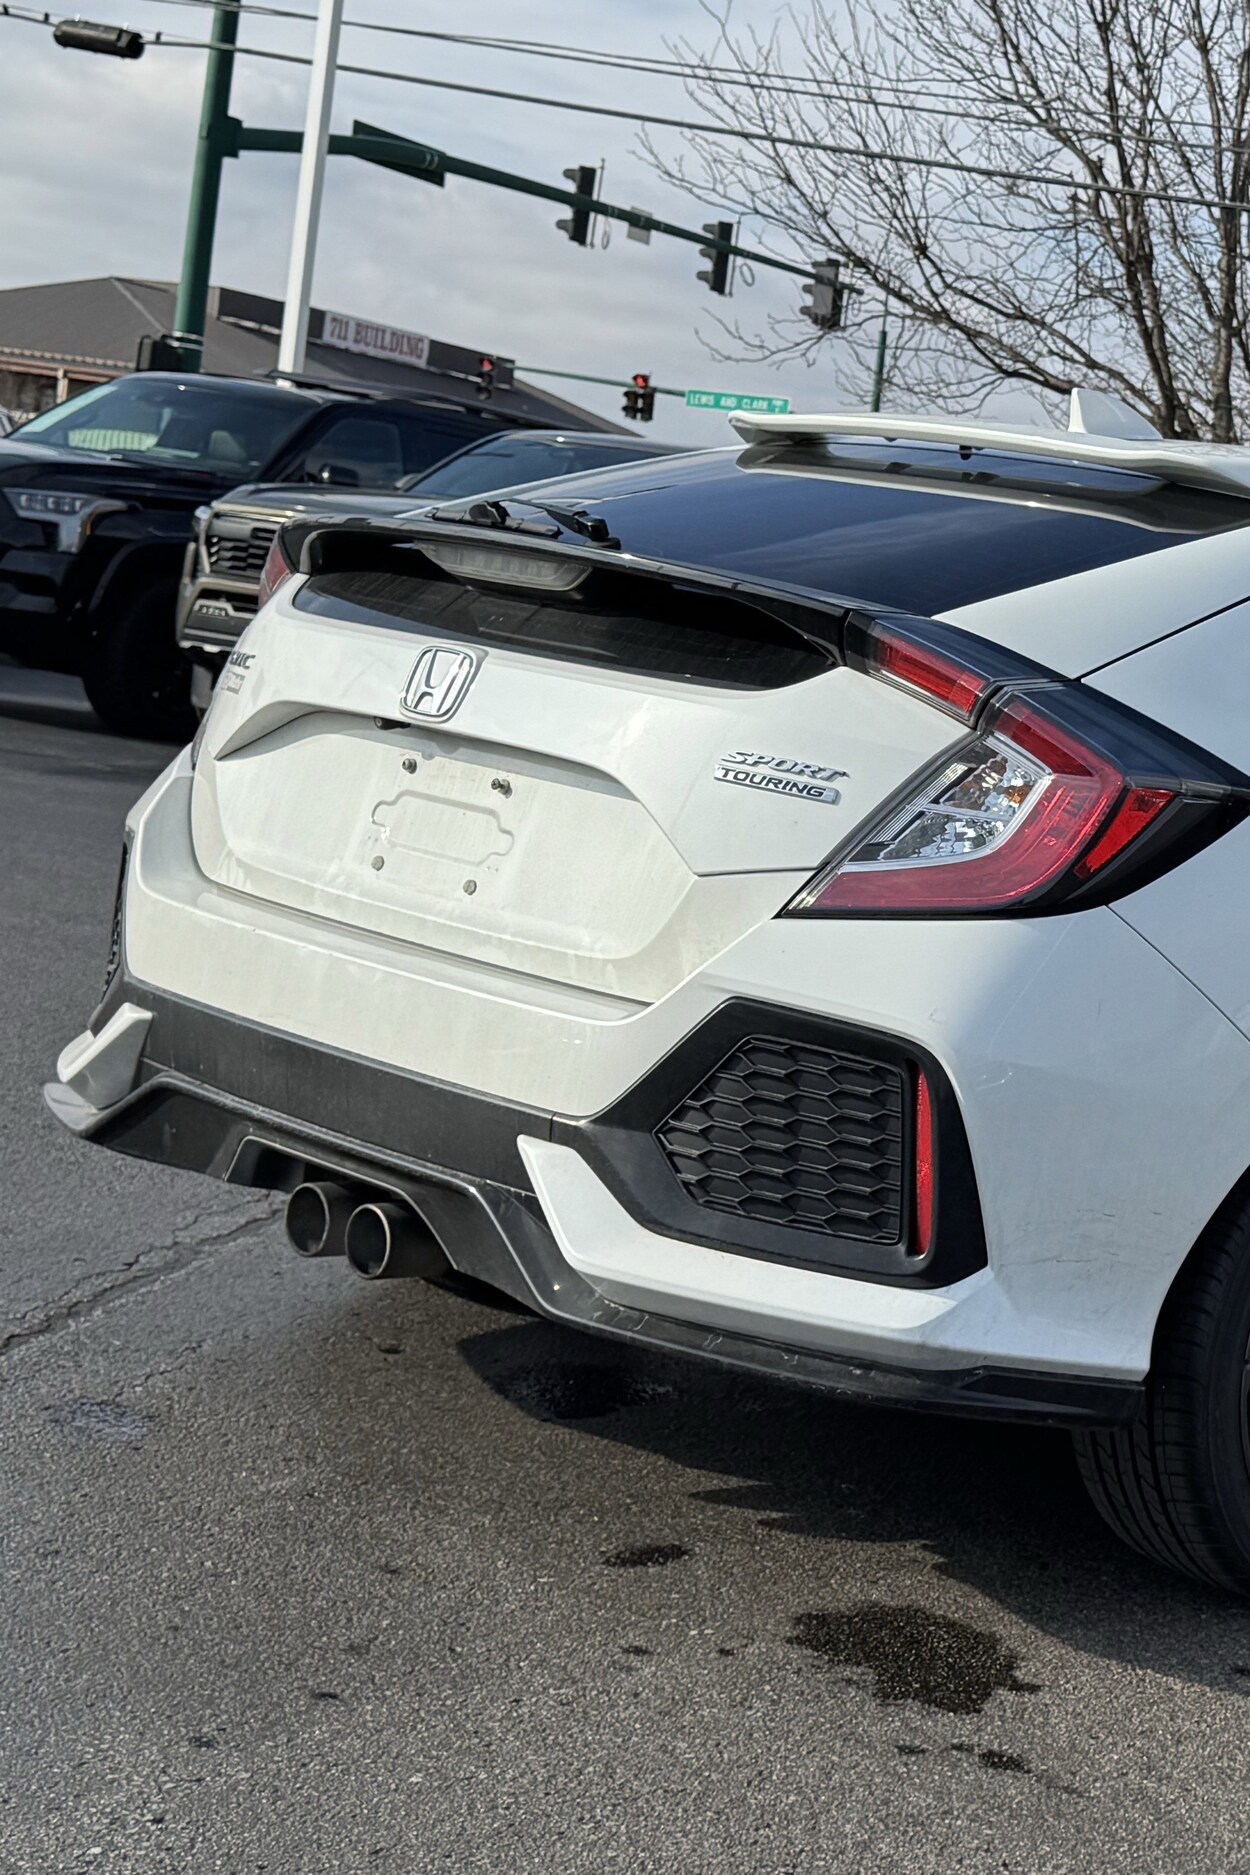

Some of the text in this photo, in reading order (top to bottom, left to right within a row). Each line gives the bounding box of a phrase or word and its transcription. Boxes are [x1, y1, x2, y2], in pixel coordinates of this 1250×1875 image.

[329, 315, 425, 360] 711 BUILDING
[689, 393, 715, 406] LEWIS
[720, 396, 738, 407] AND
[741, 398, 769, 410] CLARK
[719, 767, 827, 798] TOURING
[721, 751, 851, 783] SPORT
